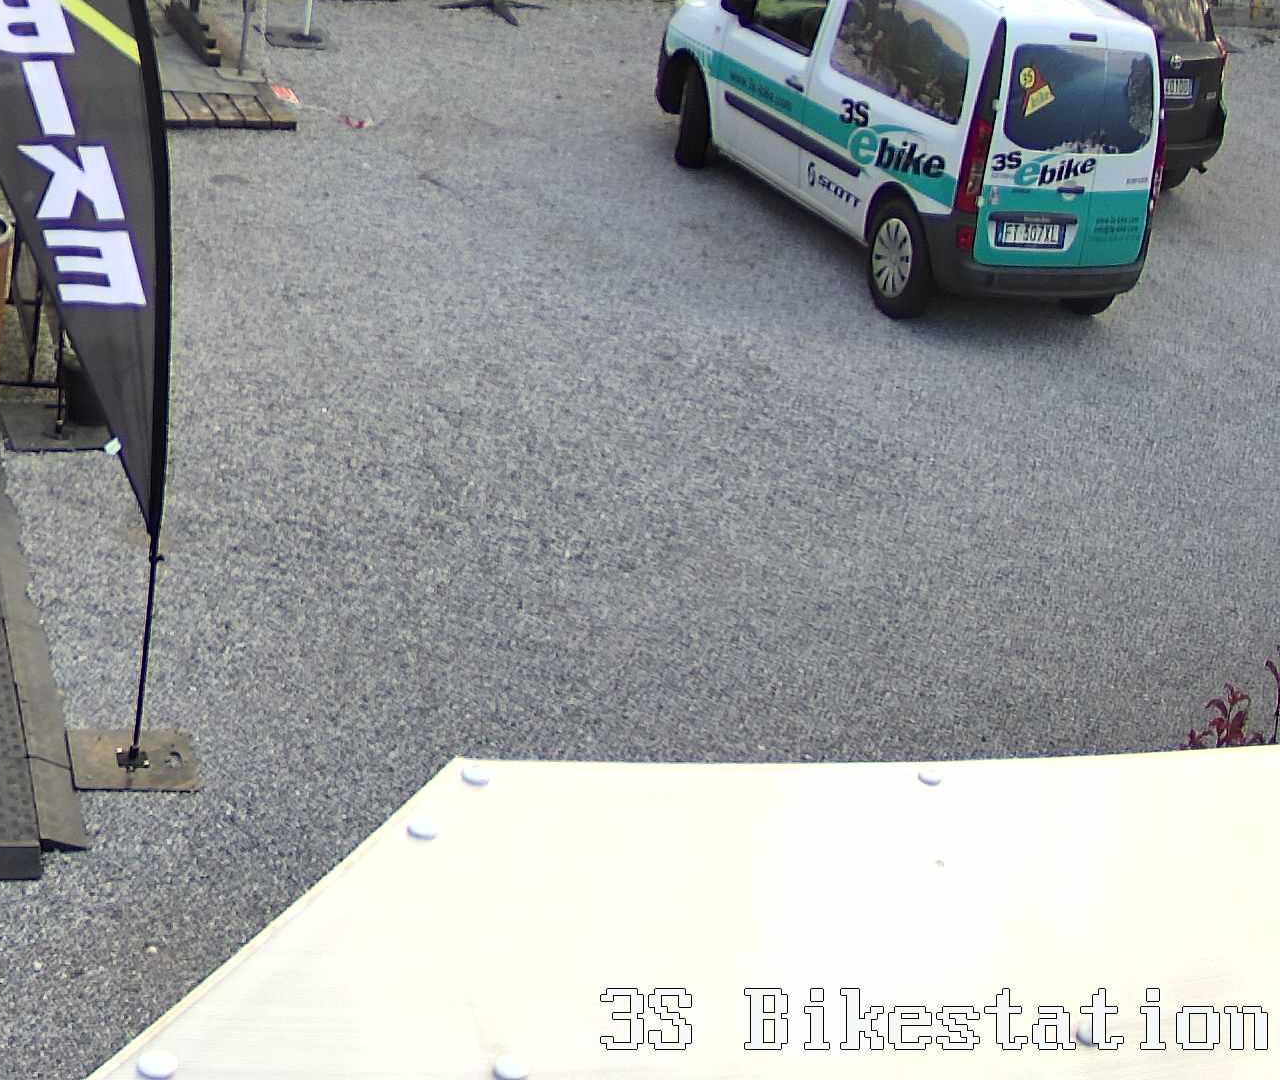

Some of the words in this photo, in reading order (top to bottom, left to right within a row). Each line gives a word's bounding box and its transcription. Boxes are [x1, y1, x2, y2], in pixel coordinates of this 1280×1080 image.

[839, 98, 870, 127] 3S
[848, 126, 945, 178] ebike
[991, 151, 1022, 172] 3S
[1014, 158, 1097, 186] ebike
[818, 175, 861, 208] SCOTT
